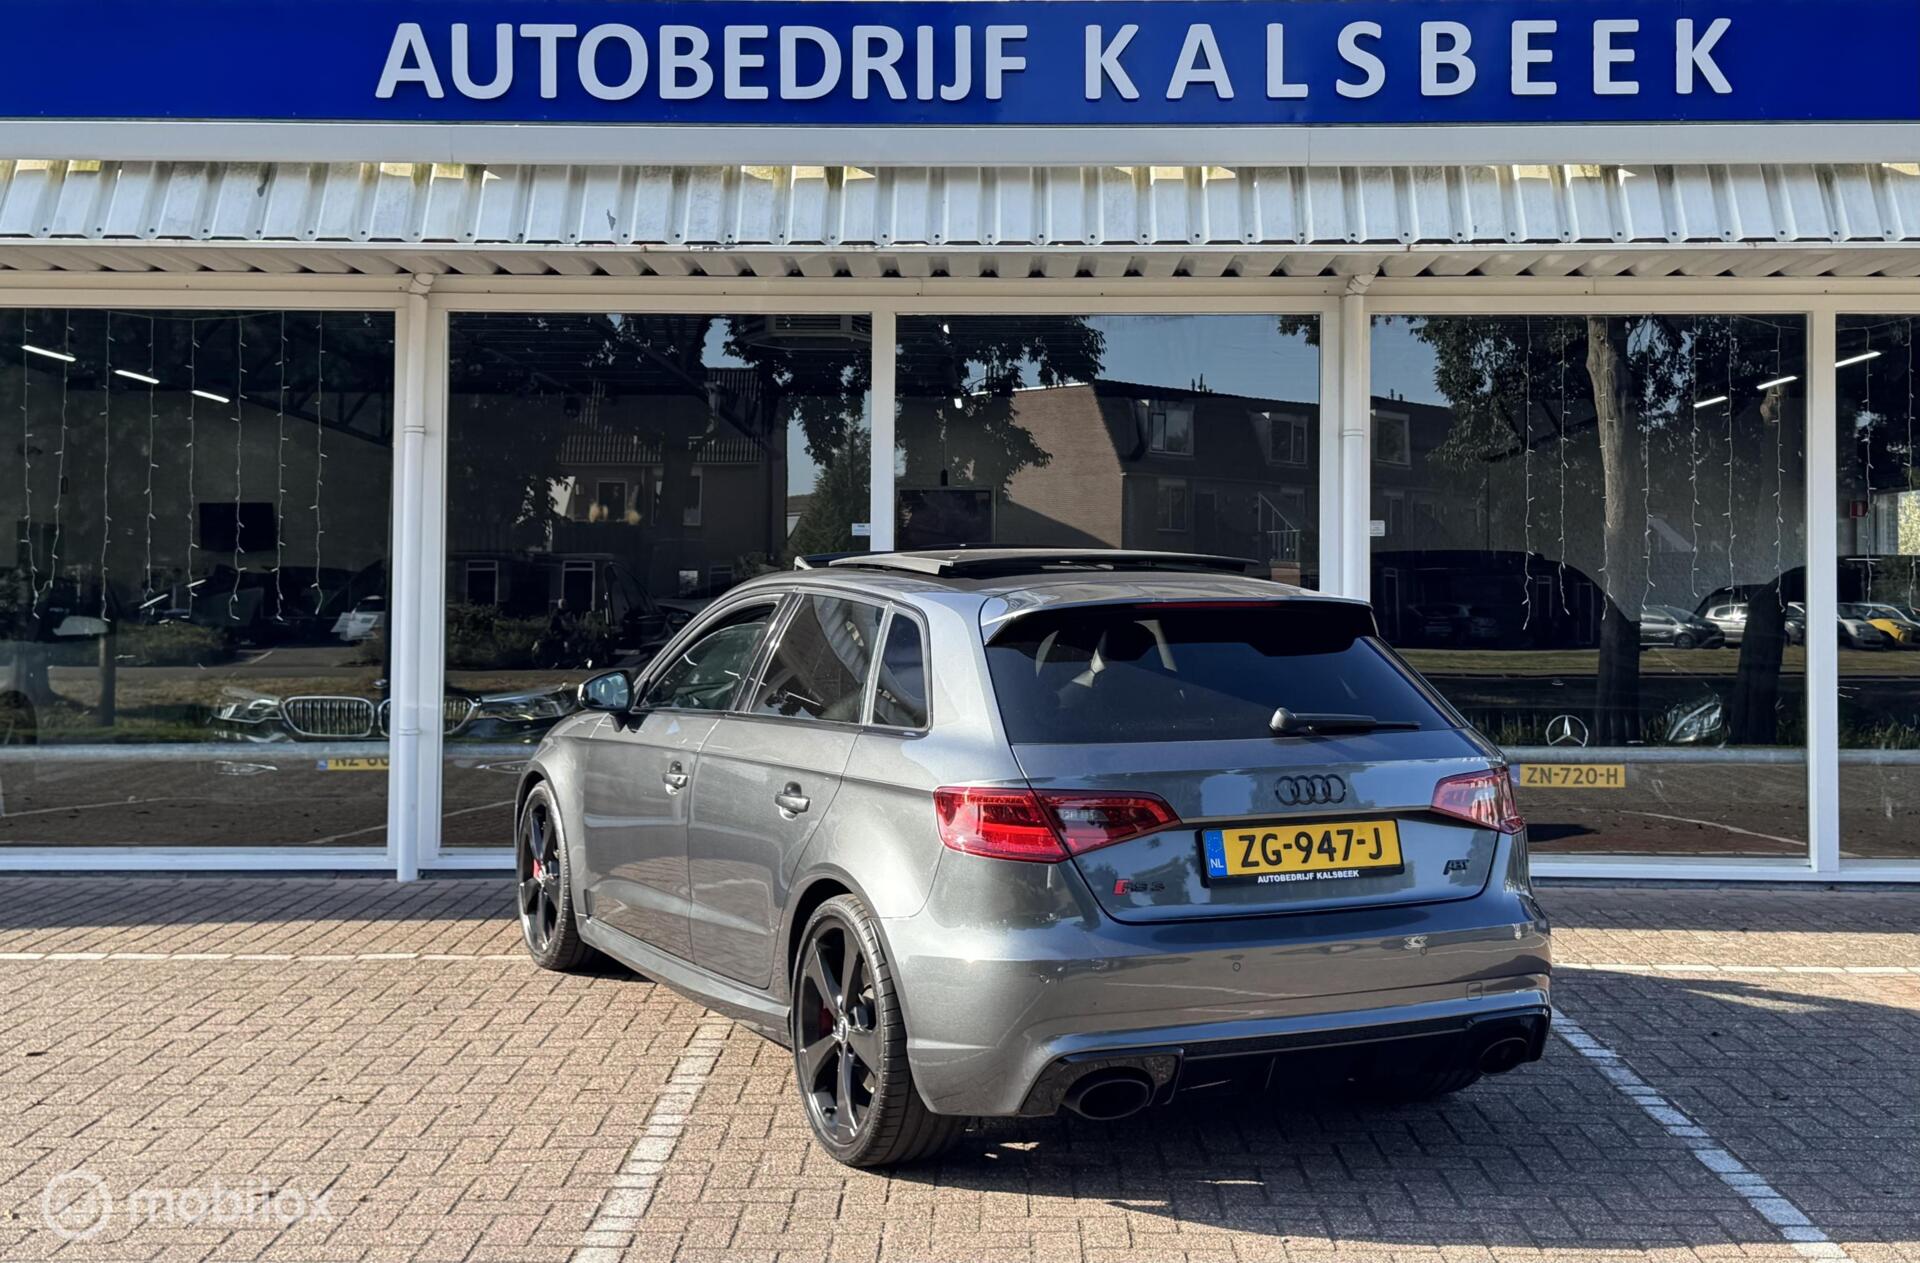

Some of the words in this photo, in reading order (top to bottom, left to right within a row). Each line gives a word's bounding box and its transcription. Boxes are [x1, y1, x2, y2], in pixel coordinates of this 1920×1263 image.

[375, 22, 1028, 101] AUTOBEDRIJF
[1085, 18, 1733, 99] KALSBEEK
[1526, 767, 1618, 785] ZN-720-H
[1238, 827, 1384, 868] ZG-947-J
[1210, 858, 1225, 869] NL
[1257, 873, 1315, 884] AUTOBEDRIJF
[1316, 869, 1360, 881] KALSBEEK
